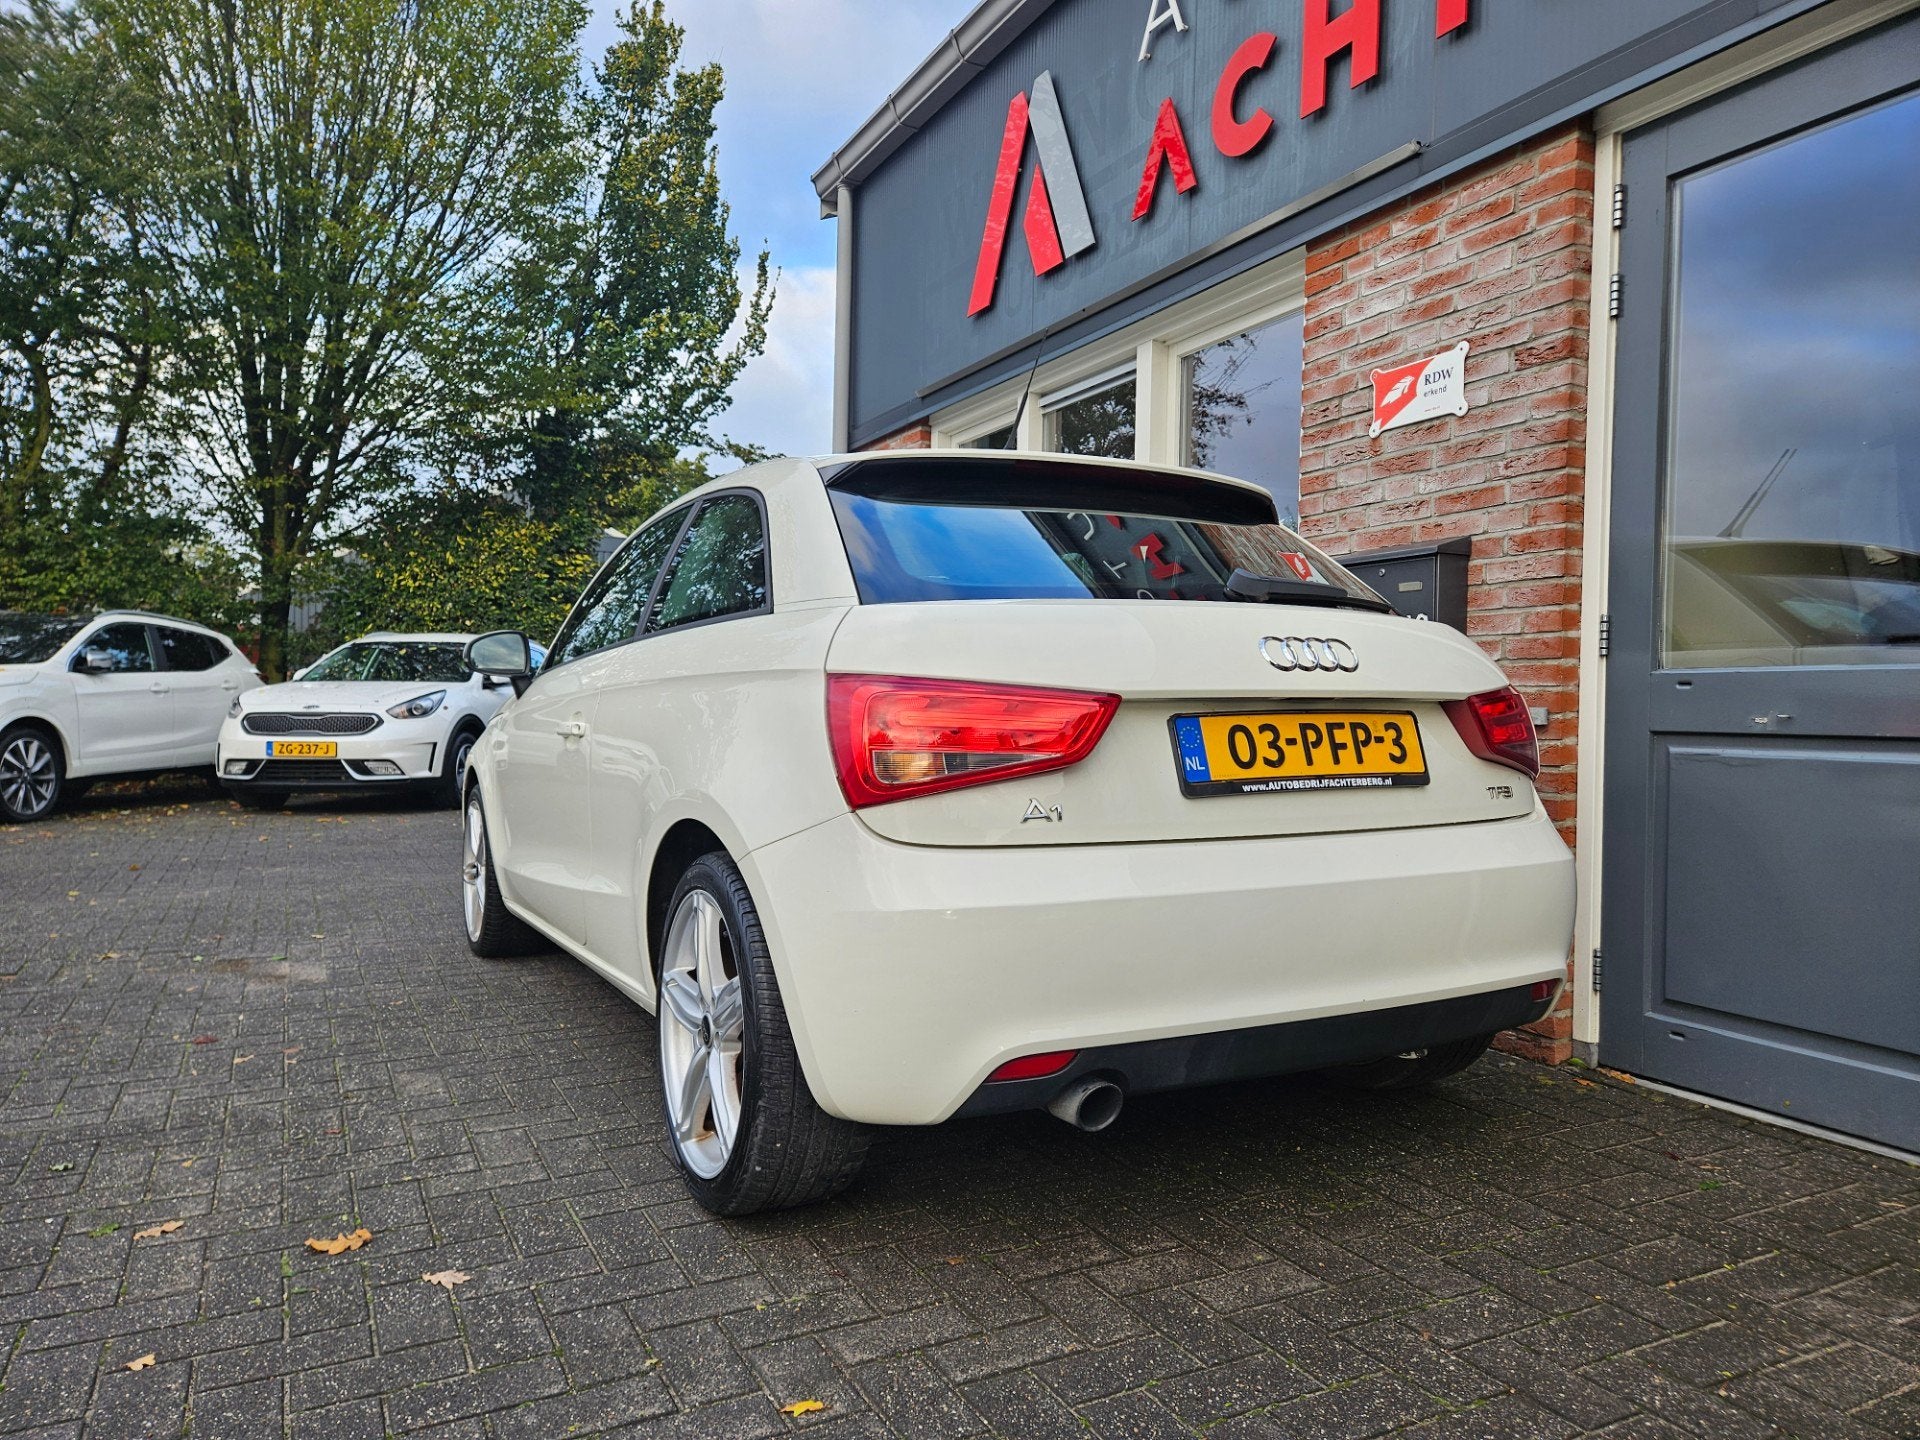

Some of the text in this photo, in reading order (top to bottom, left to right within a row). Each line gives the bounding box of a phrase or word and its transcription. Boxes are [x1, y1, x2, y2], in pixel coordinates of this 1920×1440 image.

[1424, 367, 1453, 385] RDW
[1423, 385, 1447, 398] erkend
[278, 743, 330, 755] ZG-237-J
[1227, 721, 1408, 770] 03-PFP-3
[1186, 756, 1205, 772] NL
[1242, 777, 1393, 793] www.AUTOBEDRIJFACHTERBERG.nl
[1020, 798, 1063, 823] A1
